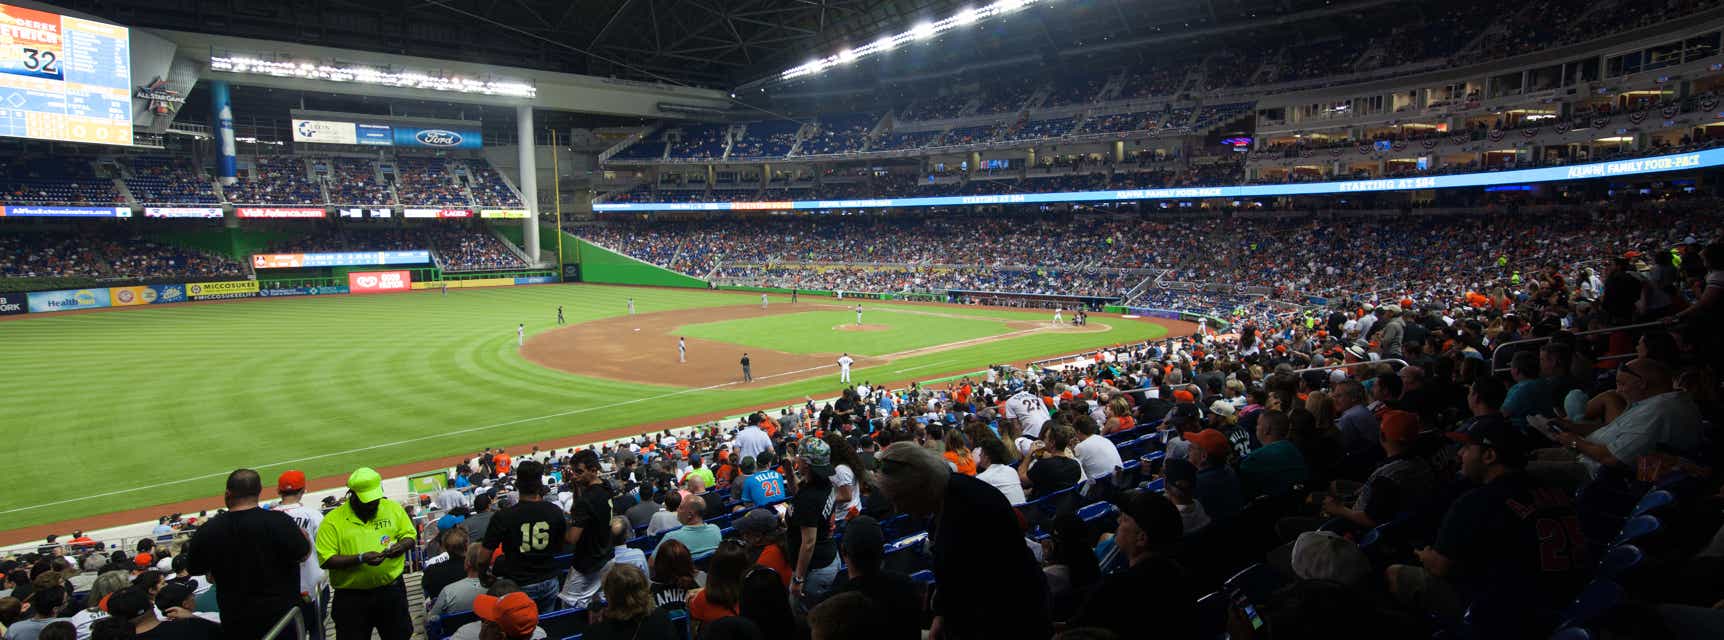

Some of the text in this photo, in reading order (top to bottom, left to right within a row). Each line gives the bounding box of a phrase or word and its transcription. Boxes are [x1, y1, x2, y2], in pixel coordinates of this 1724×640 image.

[23, 47, 57, 72] 32
[424, 131, 454, 144] Ford
[1339, 180, 1395, 192] STARTING
[762, 479, 782, 497] 21
[374, 520, 392, 530] 2171
[519, 521, 550, 553] 16
